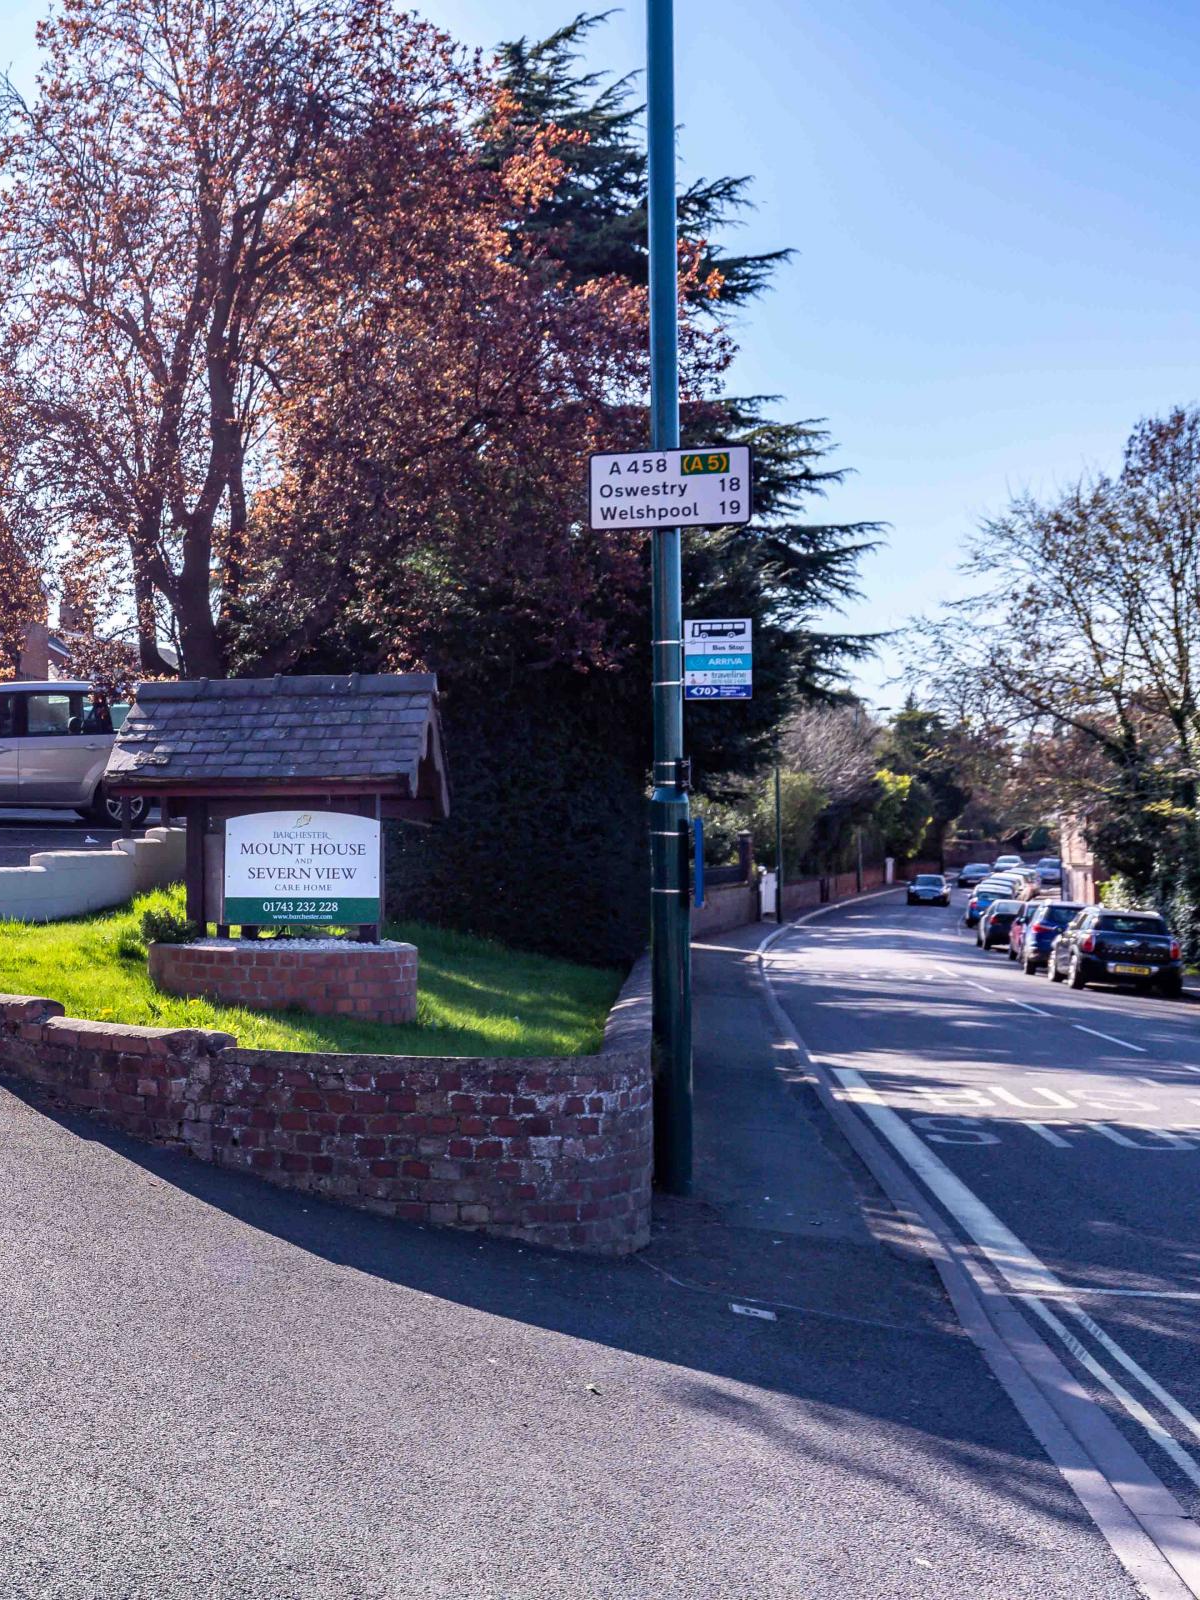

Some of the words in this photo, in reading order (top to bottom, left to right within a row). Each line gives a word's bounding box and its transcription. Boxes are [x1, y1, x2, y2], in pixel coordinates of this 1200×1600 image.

[600, 481, 688, 498] Oswestry
[719, 477, 741, 492] 18
[600, 502, 699, 521] Welshpool
[719, 500, 741, 515] 19
[708, 657, 743, 665] ARRIVA
[273, 831, 333, 840] BARCHESTER
[240, 843, 305, 855] MOUNT
[311, 843, 367, 856] HOUSE
[294, 857, 313, 865] AND
[248, 867, 311, 880] SEVERN
[314, 867, 357, 879] VIEW
[303, 884, 333, 892] HOME
[262, 902, 294, 912] 01743
[296, 902, 316, 912] 232
[318, 902, 339, 912] 228
[911, 1086, 1160, 1111] BUS
